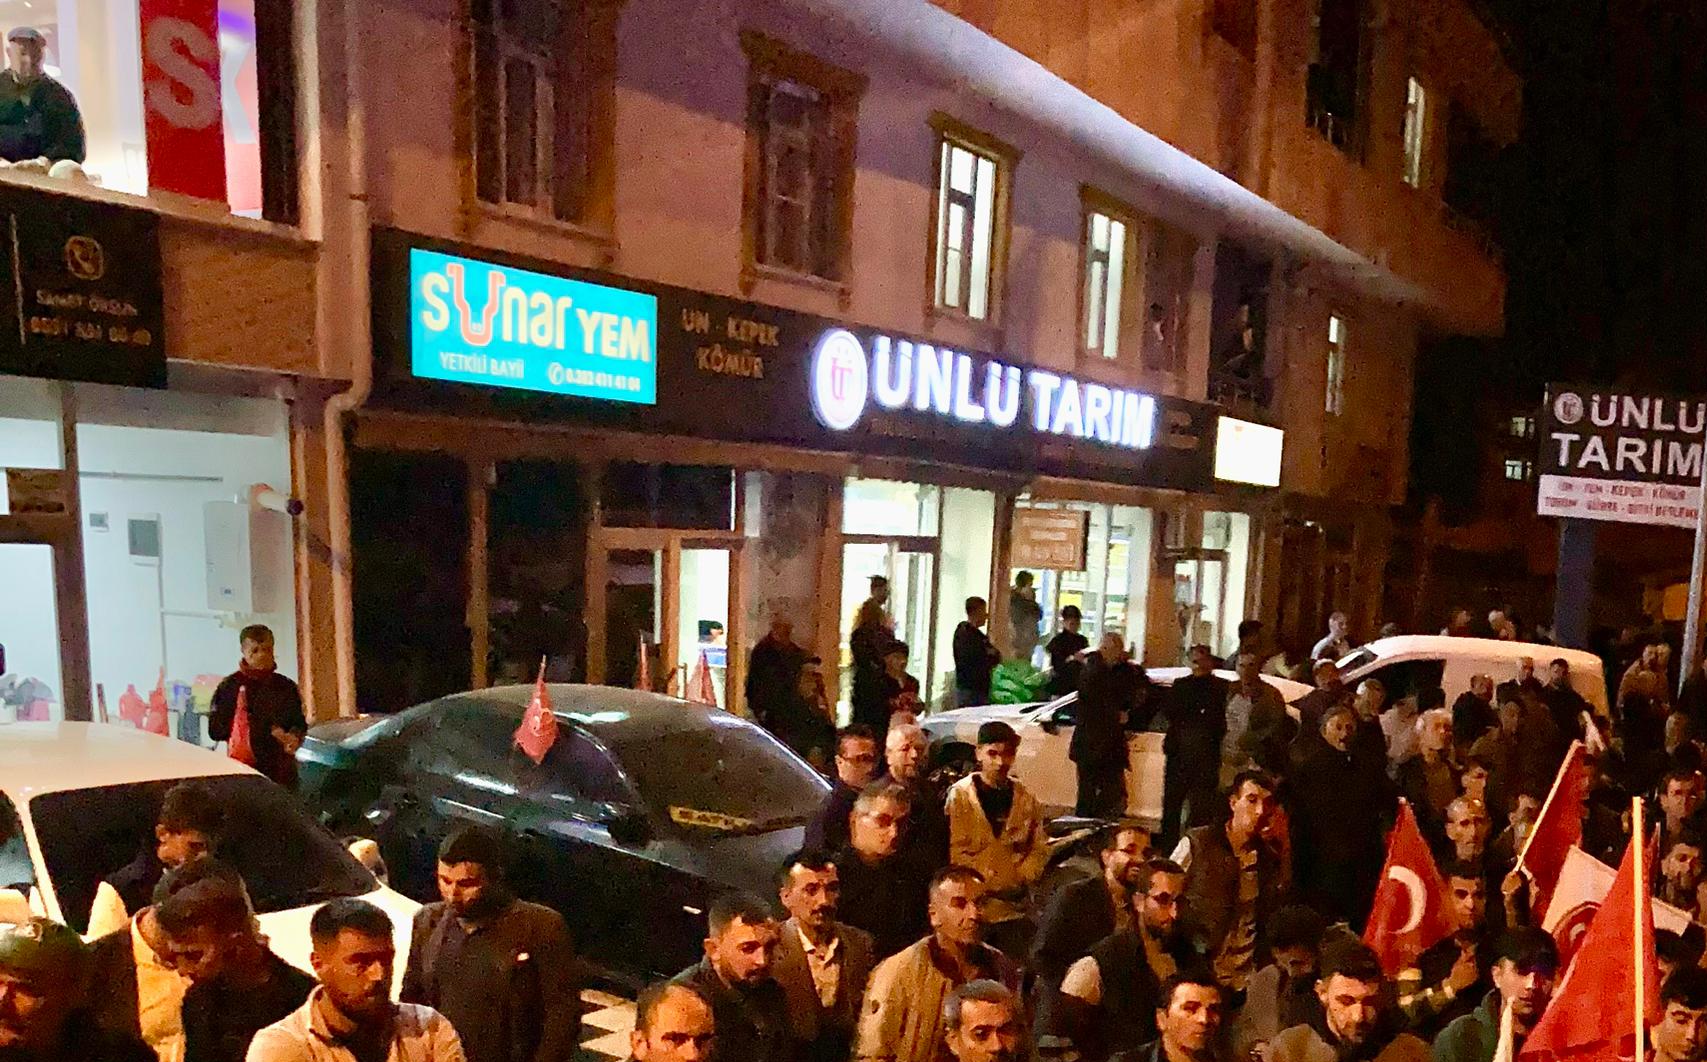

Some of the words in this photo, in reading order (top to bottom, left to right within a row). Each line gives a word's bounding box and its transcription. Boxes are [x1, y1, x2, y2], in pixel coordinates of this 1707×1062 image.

[576, 307, 651, 362] YEM
[682, 308, 709, 334] UN
[727, 317, 781, 347] KEPEK
[438, 351, 487, 375] YETKİLİ
[696, 343, 765, 380] KÖMÜR
[872, 334, 1022, 428] ÜNLÜ
[1027, 370, 1157, 450] TARIM
[1590, 393, 1707, 434] ÜNLÜ
[1550, 431, 1703, 478] TARIM
